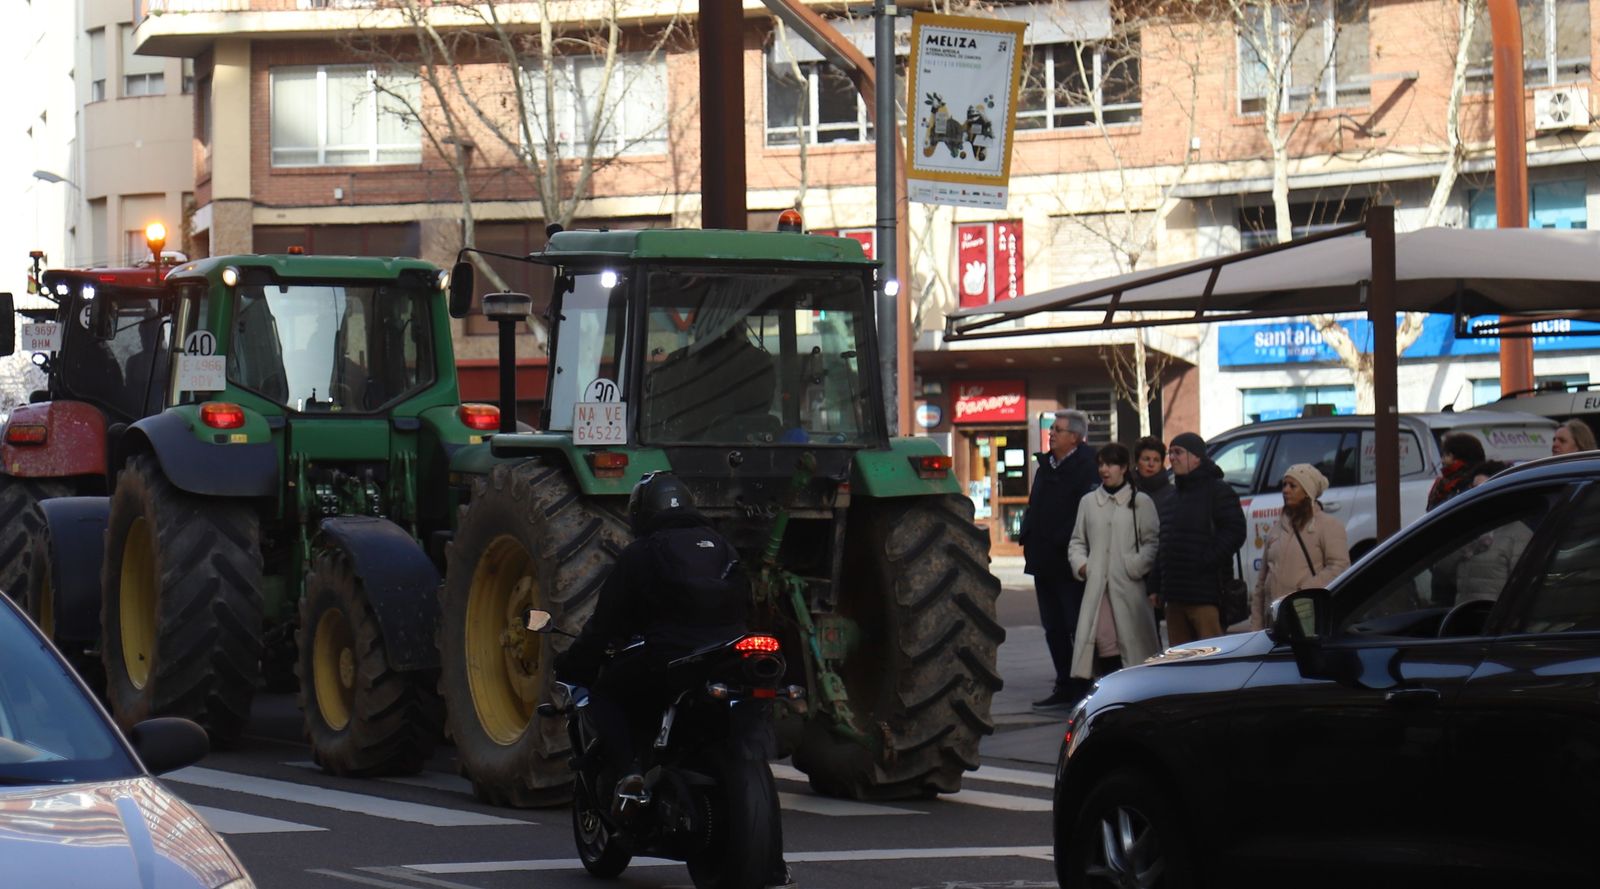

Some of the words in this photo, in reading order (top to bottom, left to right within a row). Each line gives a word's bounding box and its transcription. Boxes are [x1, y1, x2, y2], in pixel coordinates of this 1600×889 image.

[926, 35, 977, 49] MELIZA
[1008, 233, 1017, 298] ARTESANO
[34, 325, 57, 336] 9697
[188, 334, 211, 356] 40
[595, 381, 614, 403] 30
[579, 407, 595, 420] NA
[605, 407, 621, 420] VE
[578, 426, 622, 440] 64522
